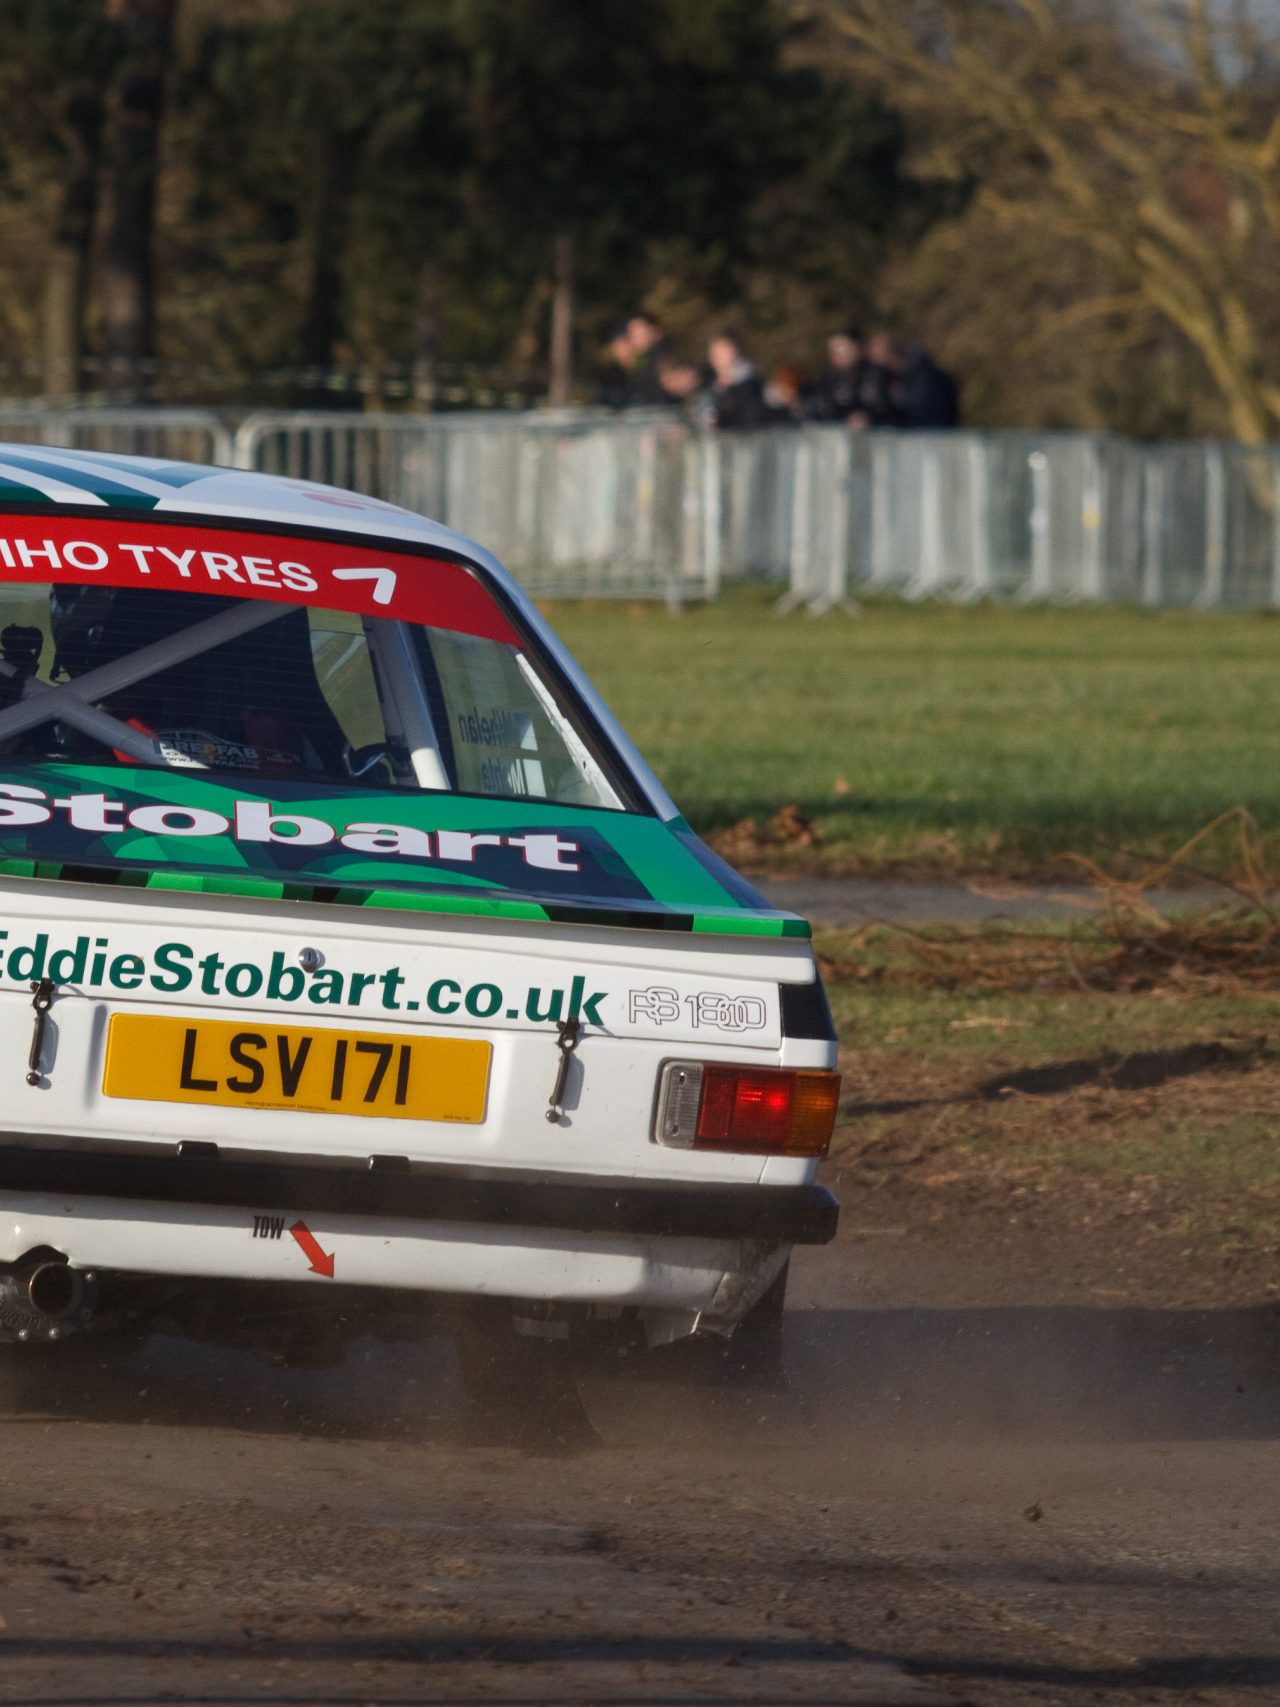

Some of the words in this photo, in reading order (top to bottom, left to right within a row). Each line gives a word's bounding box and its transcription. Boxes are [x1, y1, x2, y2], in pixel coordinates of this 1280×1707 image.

[118, 543, 319, 592] TYRES
[628, 985, 680, 1026] RS
[179, 1028, 314, 1098] LSV
[330, 1039, 412, 1106] 171
[252, 1215, 286, 1240] TOW
